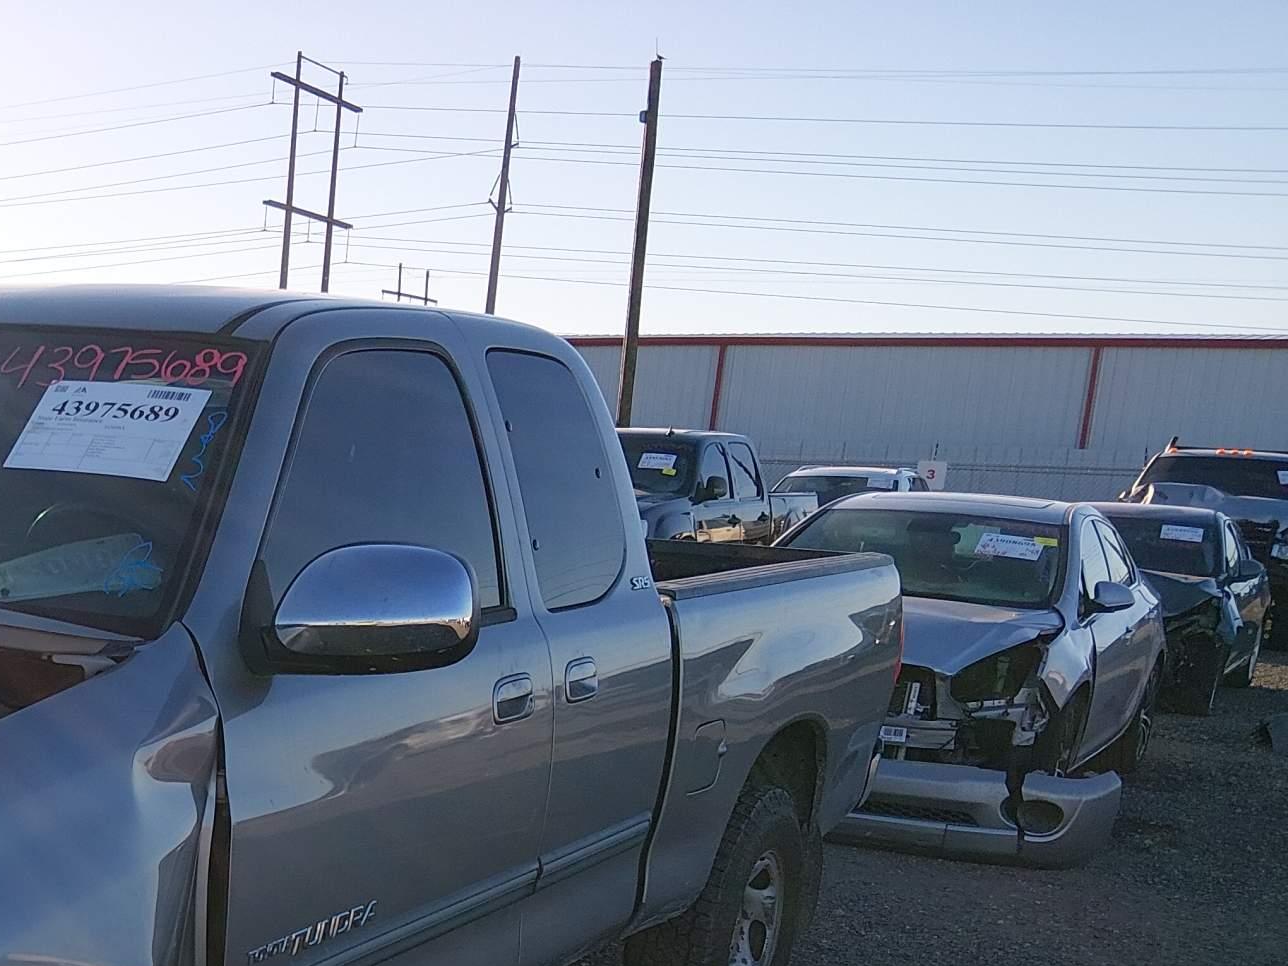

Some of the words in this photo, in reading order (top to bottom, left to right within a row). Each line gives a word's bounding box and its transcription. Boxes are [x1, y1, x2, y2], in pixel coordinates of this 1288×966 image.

[1, 344, 248, 389] 43975689
[52, 399, 180, 423] 43975689
[926, 469, 936, 480] 3
[290, 900, 377, 956] TUNDRA
